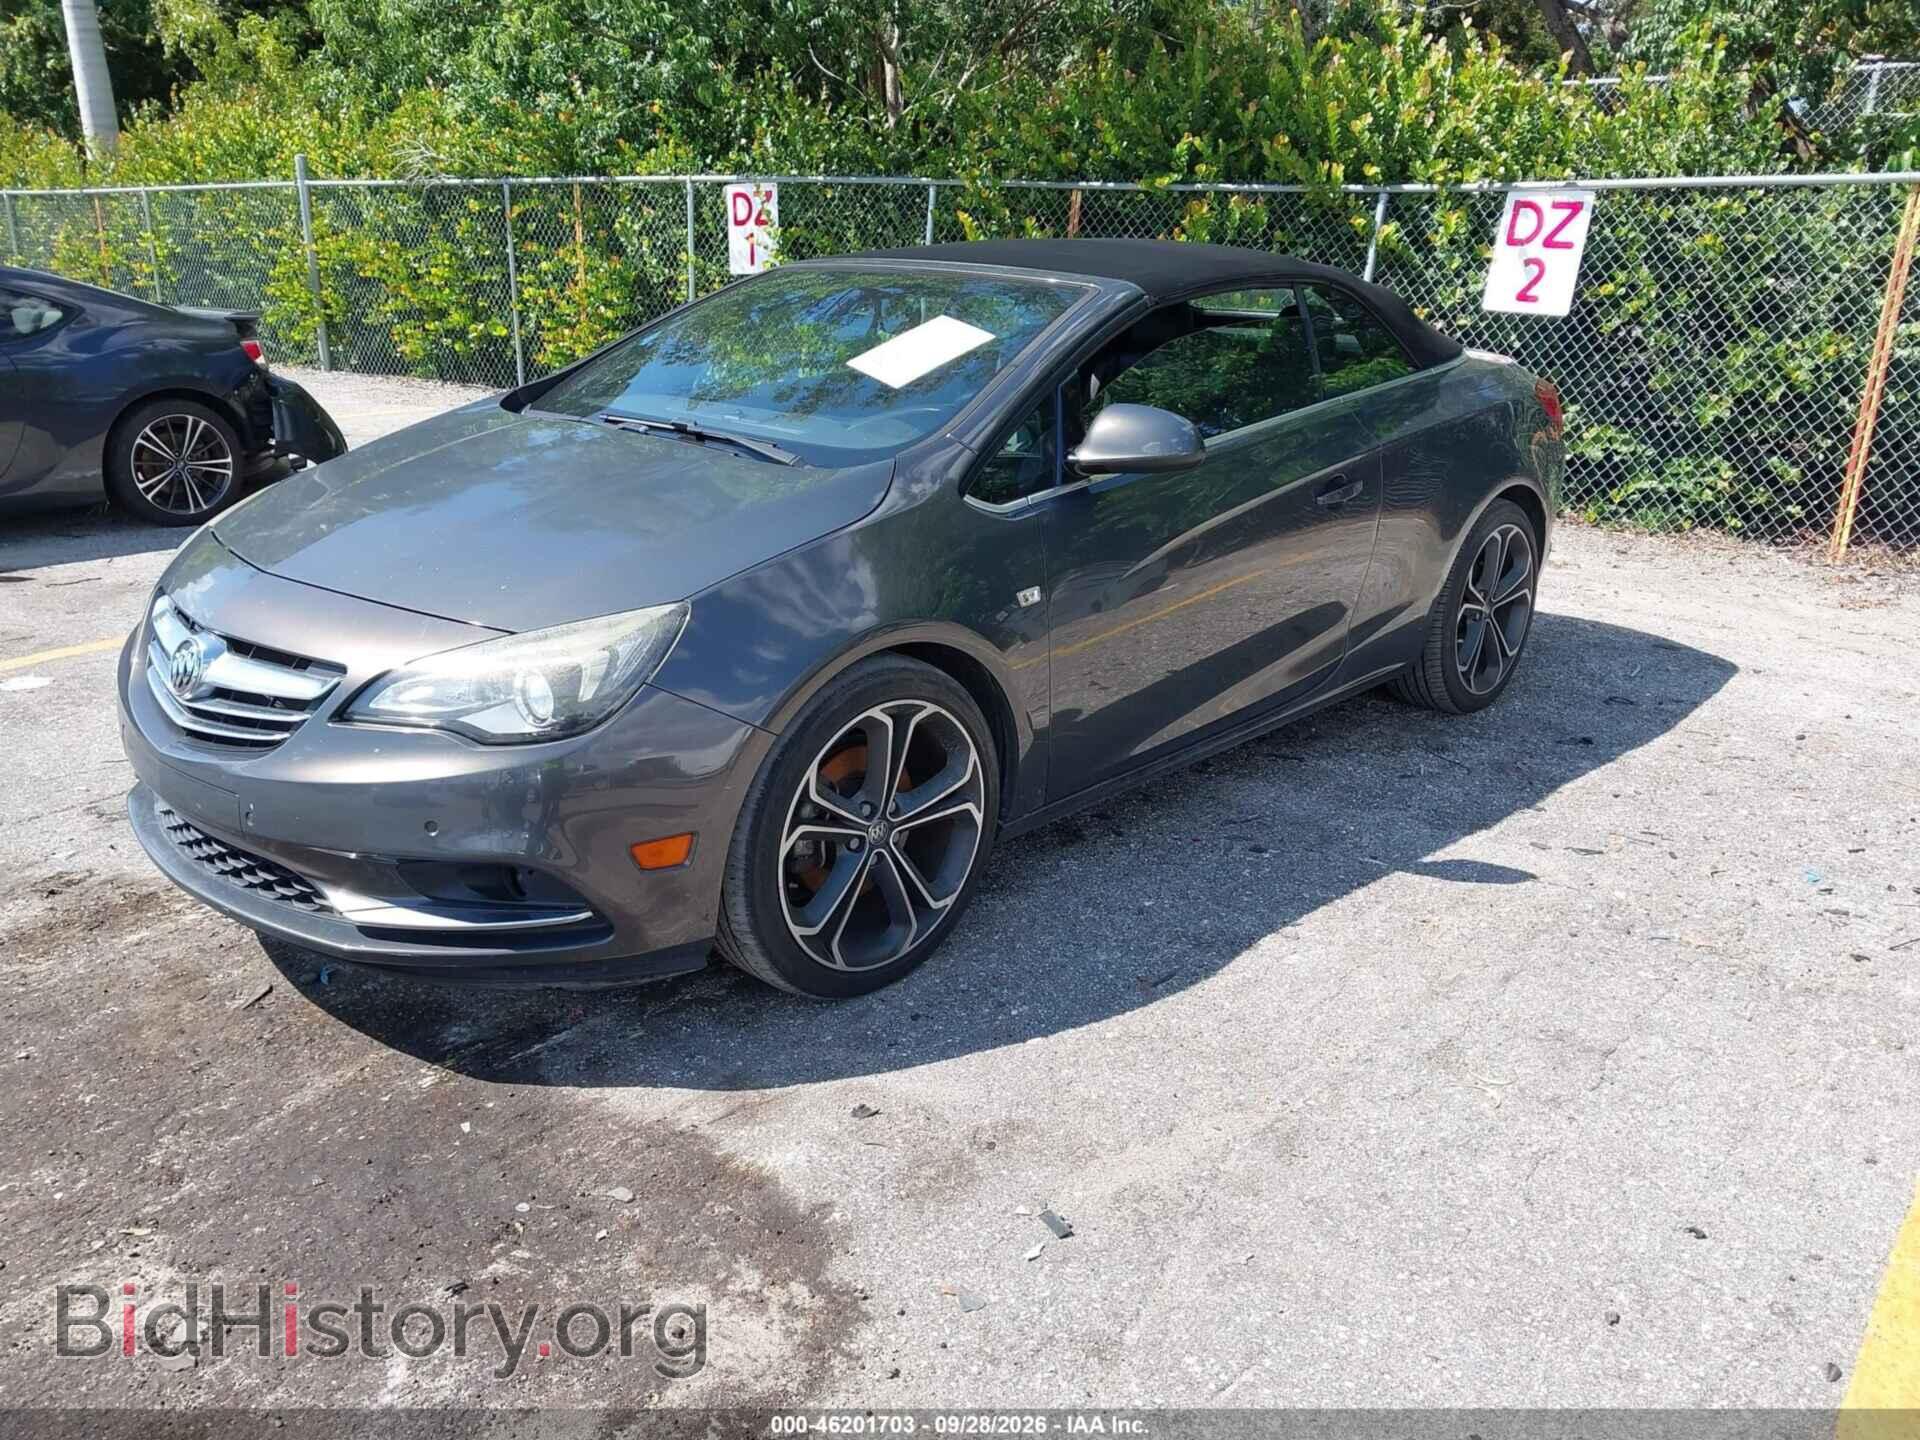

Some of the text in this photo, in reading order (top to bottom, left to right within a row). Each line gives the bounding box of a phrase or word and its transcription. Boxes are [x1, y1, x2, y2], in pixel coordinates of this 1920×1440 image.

[1506, 199, 1585, 249] DZ
[744, 231, 756, 267] 1
[1515, 257, 1547, 302] 2
